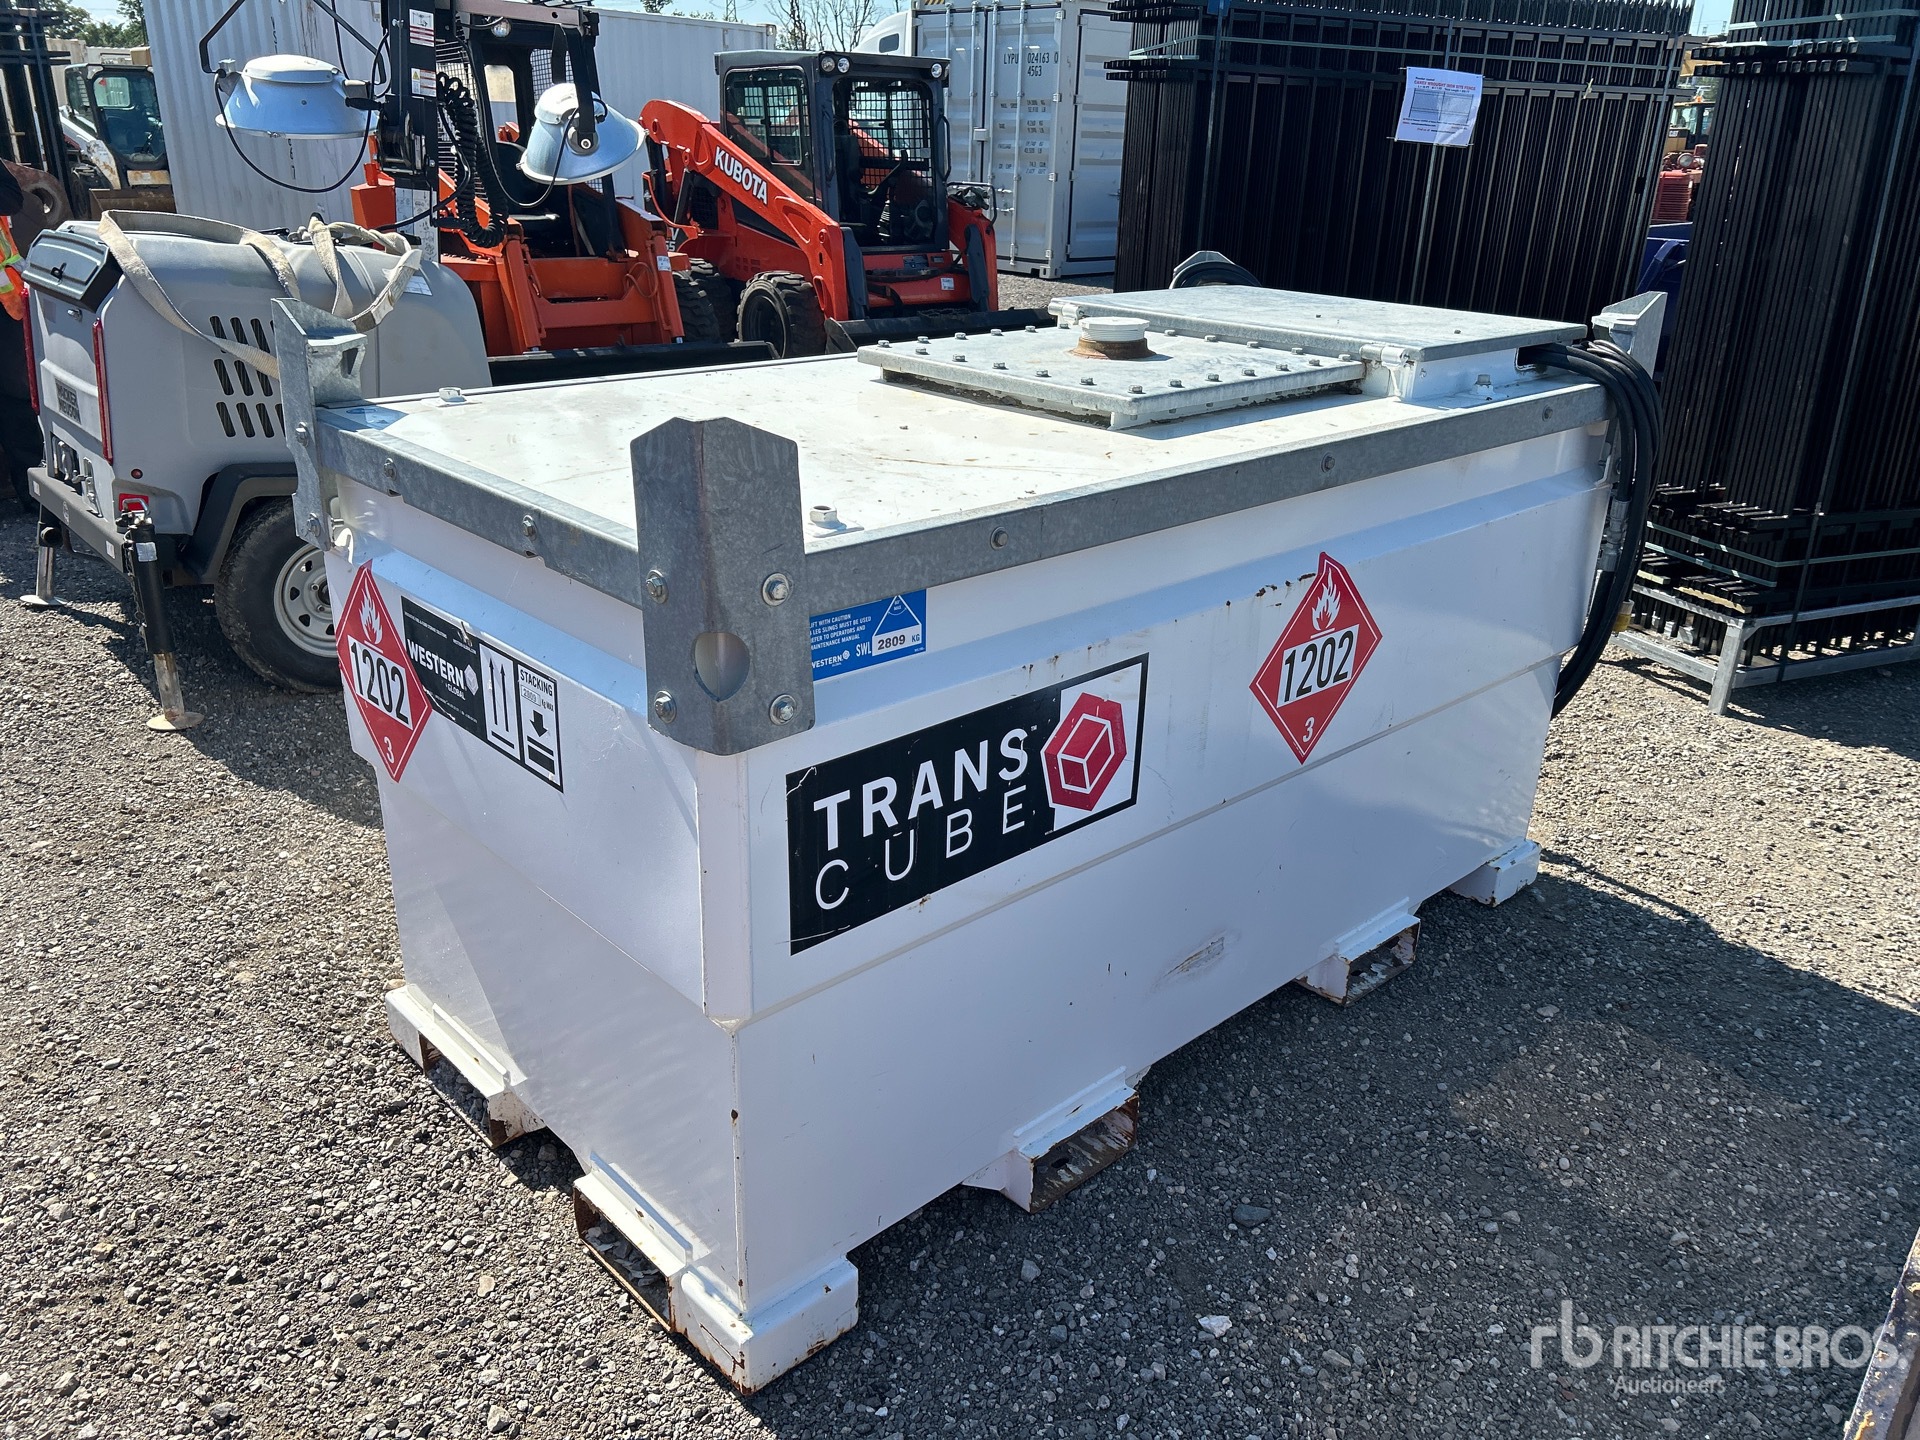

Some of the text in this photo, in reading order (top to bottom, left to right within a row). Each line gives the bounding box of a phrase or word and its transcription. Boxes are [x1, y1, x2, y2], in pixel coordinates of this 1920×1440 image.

[1004, 53, 1019, 64] LYPU
[1027, 52, 1050, 64] 024163
[1027, 66, 1042, 76] 45G3
[715, 146, 768, 204] KUBOTA
[832, 614, 851, 623] CAUTION
[830, 627, 855, 638] OPERATORS
[841, 634, 860, 643] MANUAL
[856, 634, 920, 657] SWL 2809 KG
[407, 638, 465, 690] WESTERN
[1284, 630, 1354, 702] 1202
[351, 641, 409, 725] 1202
[520, 670, 552, 696] STACKING
[1303, 716, 1314, 742] 3
[384, 736, 394, 764] 3
[813, 728, 1028, 851] TRANS
[815, 784, 1027, 910] CUBE
